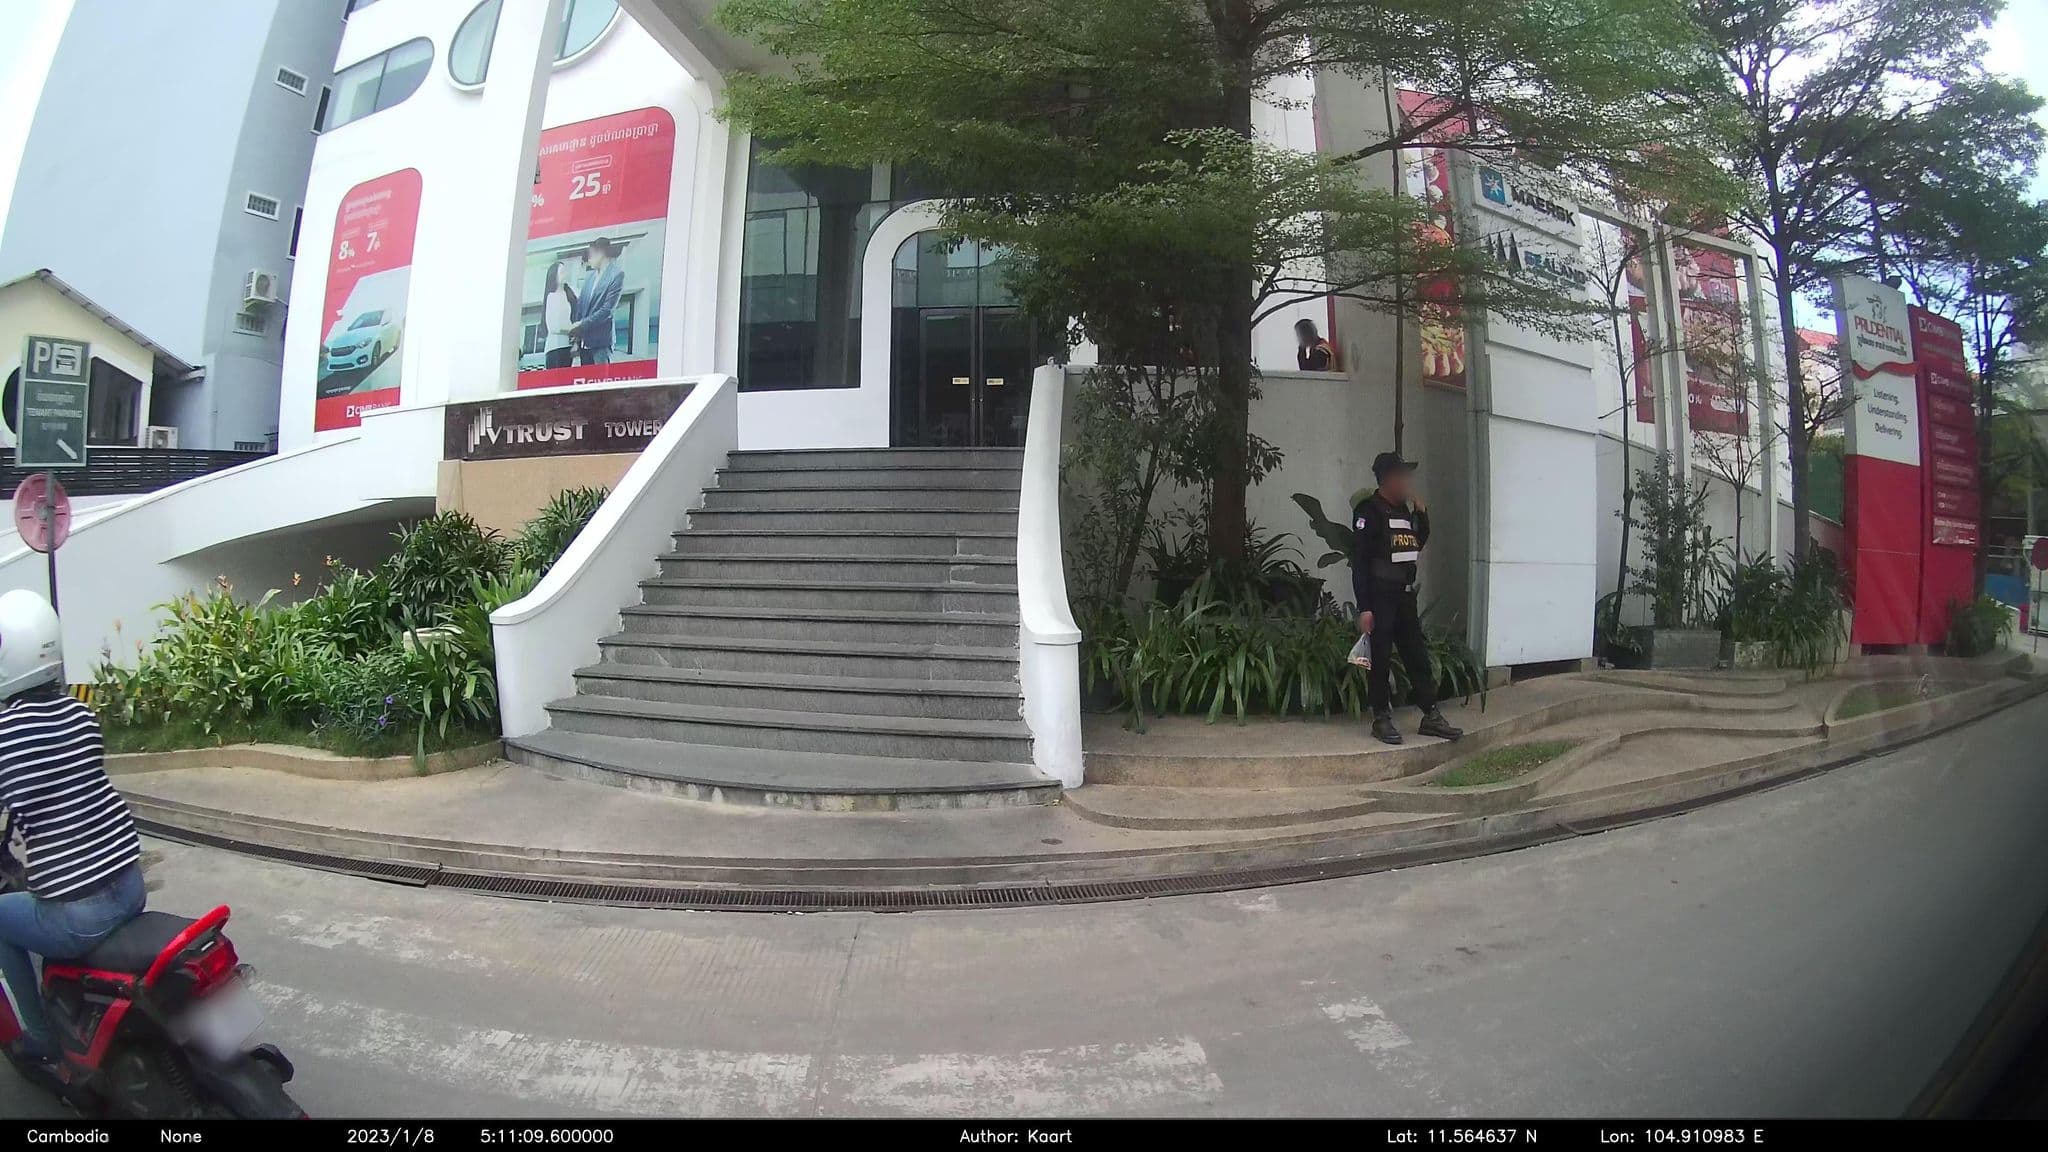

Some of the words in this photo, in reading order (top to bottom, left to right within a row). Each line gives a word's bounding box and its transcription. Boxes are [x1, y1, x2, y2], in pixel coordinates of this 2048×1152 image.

[569, 172, 601, 200] 25
[1854, 315, 1906, 346] PRUDENTIAL
[32, 341, 52, 374] P
[604, 418, 665, 438] TOWER
